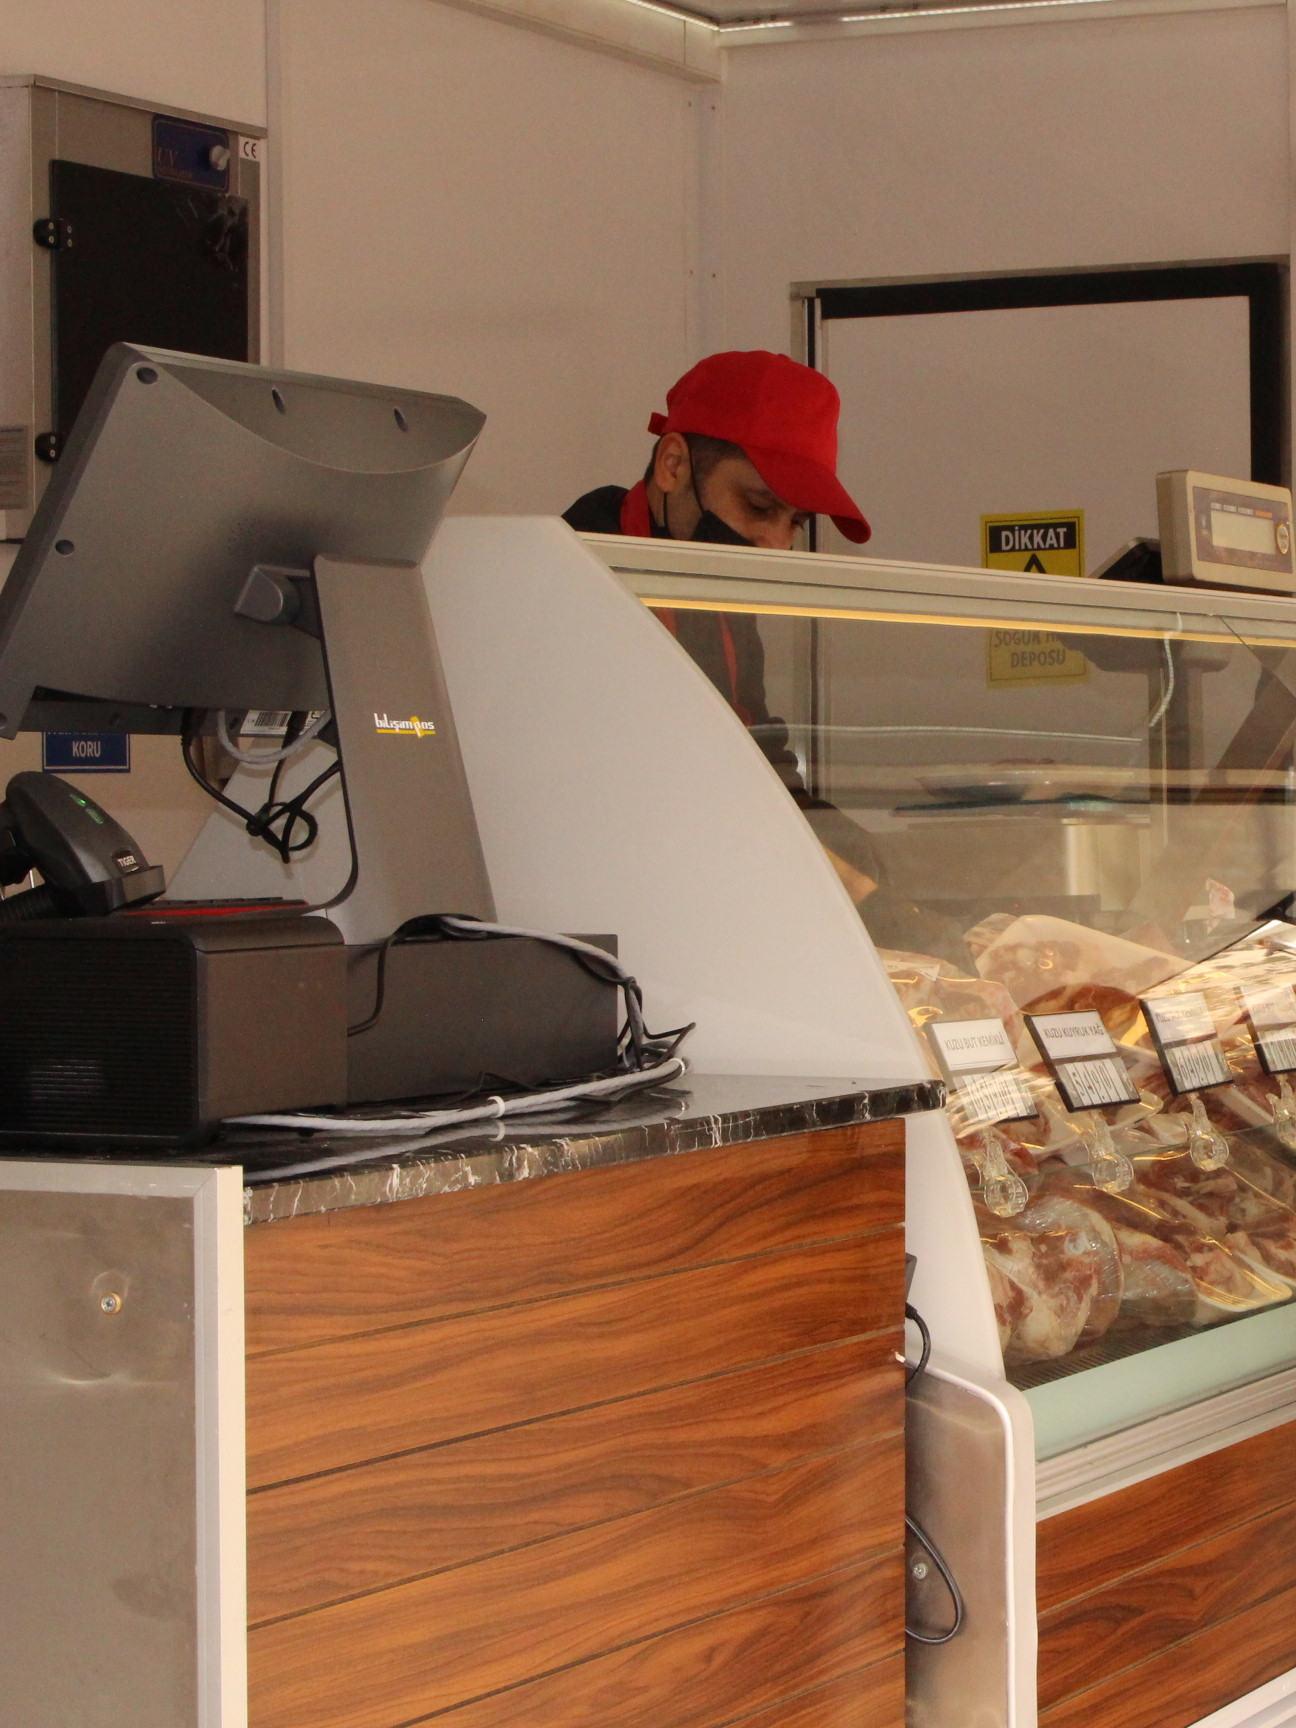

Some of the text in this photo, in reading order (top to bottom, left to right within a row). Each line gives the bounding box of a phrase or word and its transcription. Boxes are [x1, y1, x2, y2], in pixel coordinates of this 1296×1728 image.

[1001, 526, 1067, 551] DİKKAT
[1011, 649, 1066, 668] DEPOSU
[72, 740, 101, 758] KORU
[117, 855, 137, 867] TIGER
[1043, 1027, 1063, 1039] KUZU
[1063, 1025, 1091, 1038] KUYRUK
[944, 1038, 965, 1051] KUZU
[964, 1036, 978, 1049] BUT
